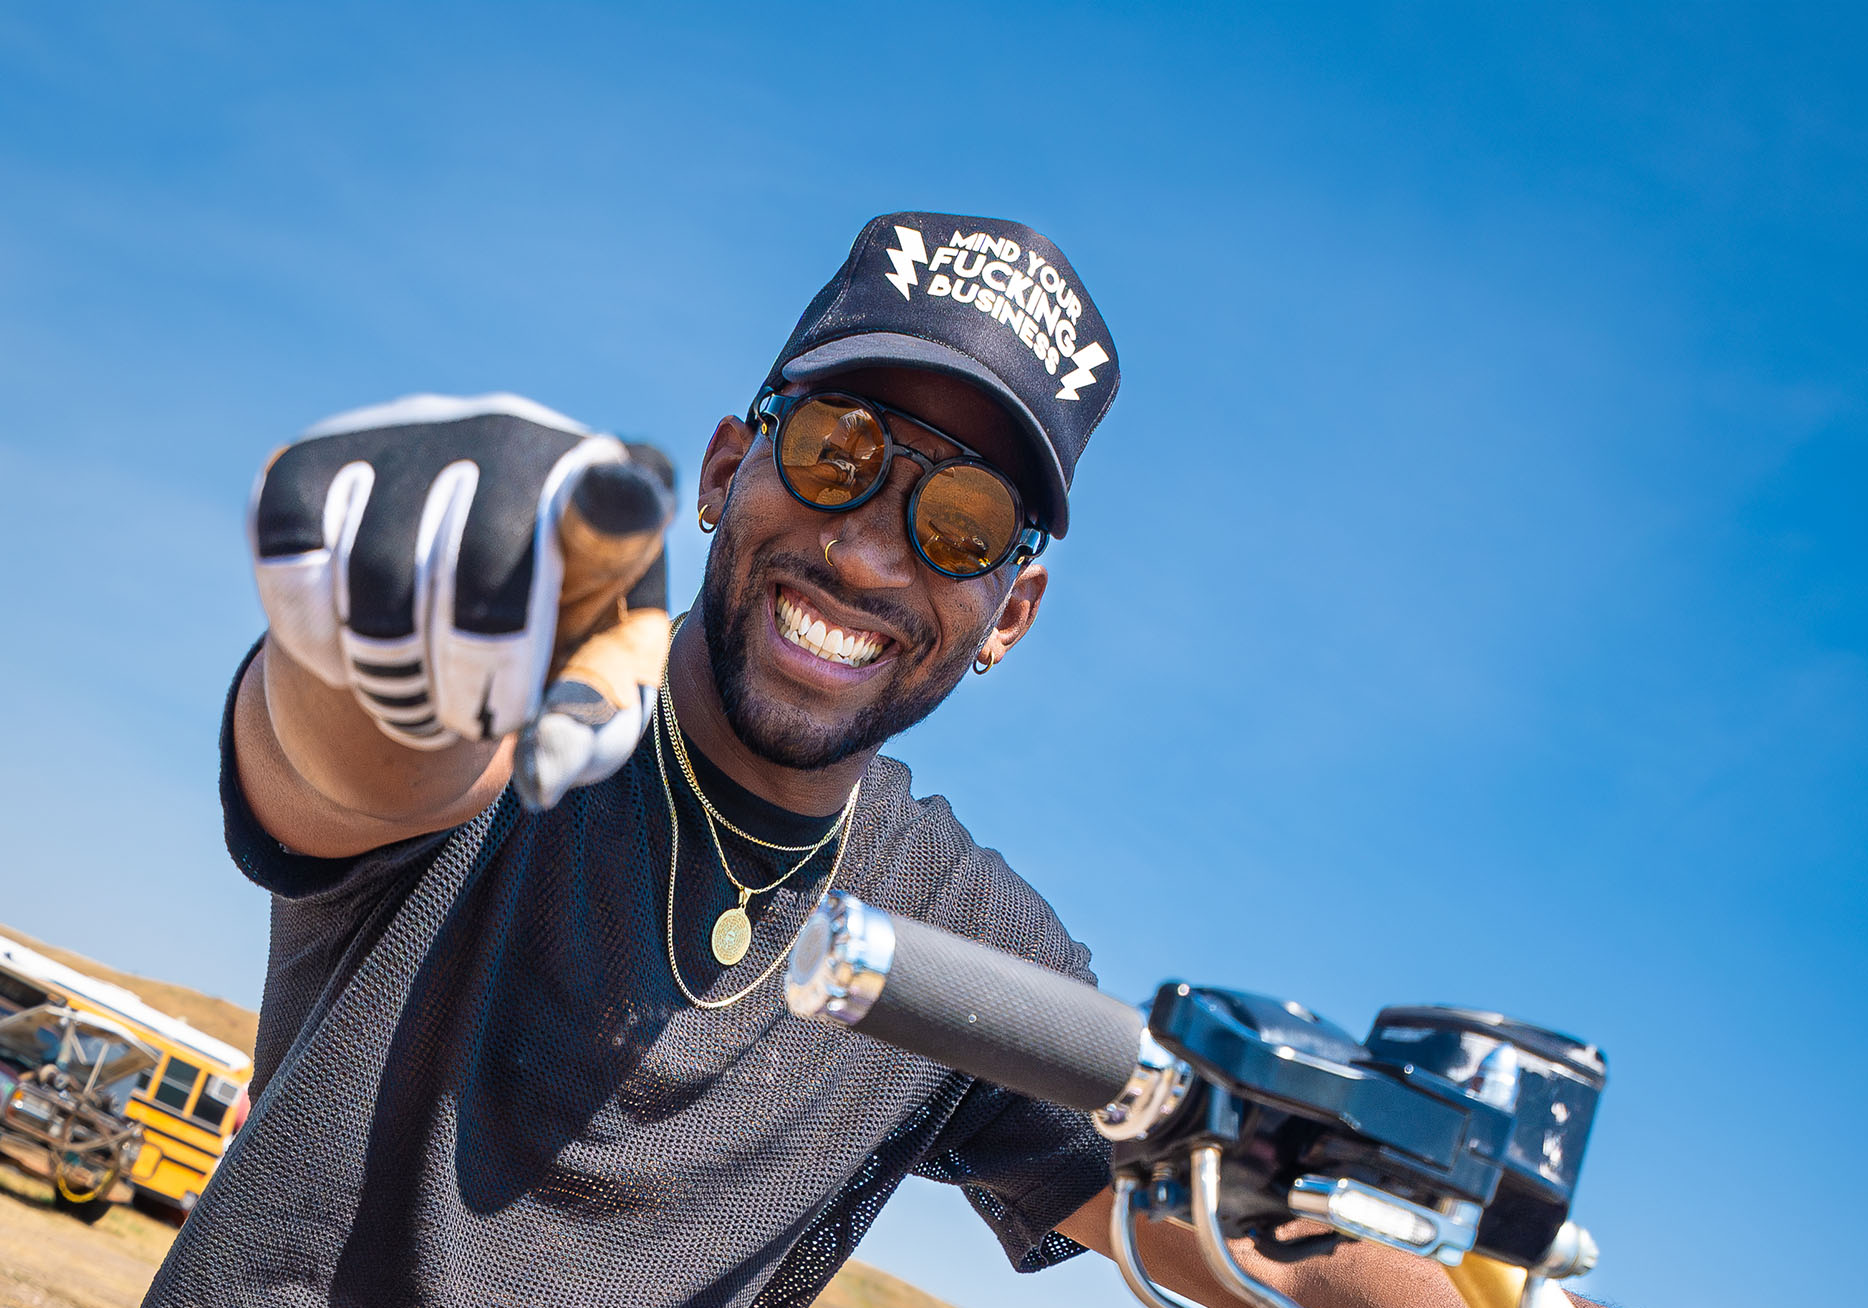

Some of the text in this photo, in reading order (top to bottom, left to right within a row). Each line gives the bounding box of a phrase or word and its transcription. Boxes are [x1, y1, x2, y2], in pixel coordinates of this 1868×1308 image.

[927, 274, 1060, 376] BUSINESS
[928, 246, 1077, 358] FUCKING
[949, 230, 1082, 325] MIND YOUR
